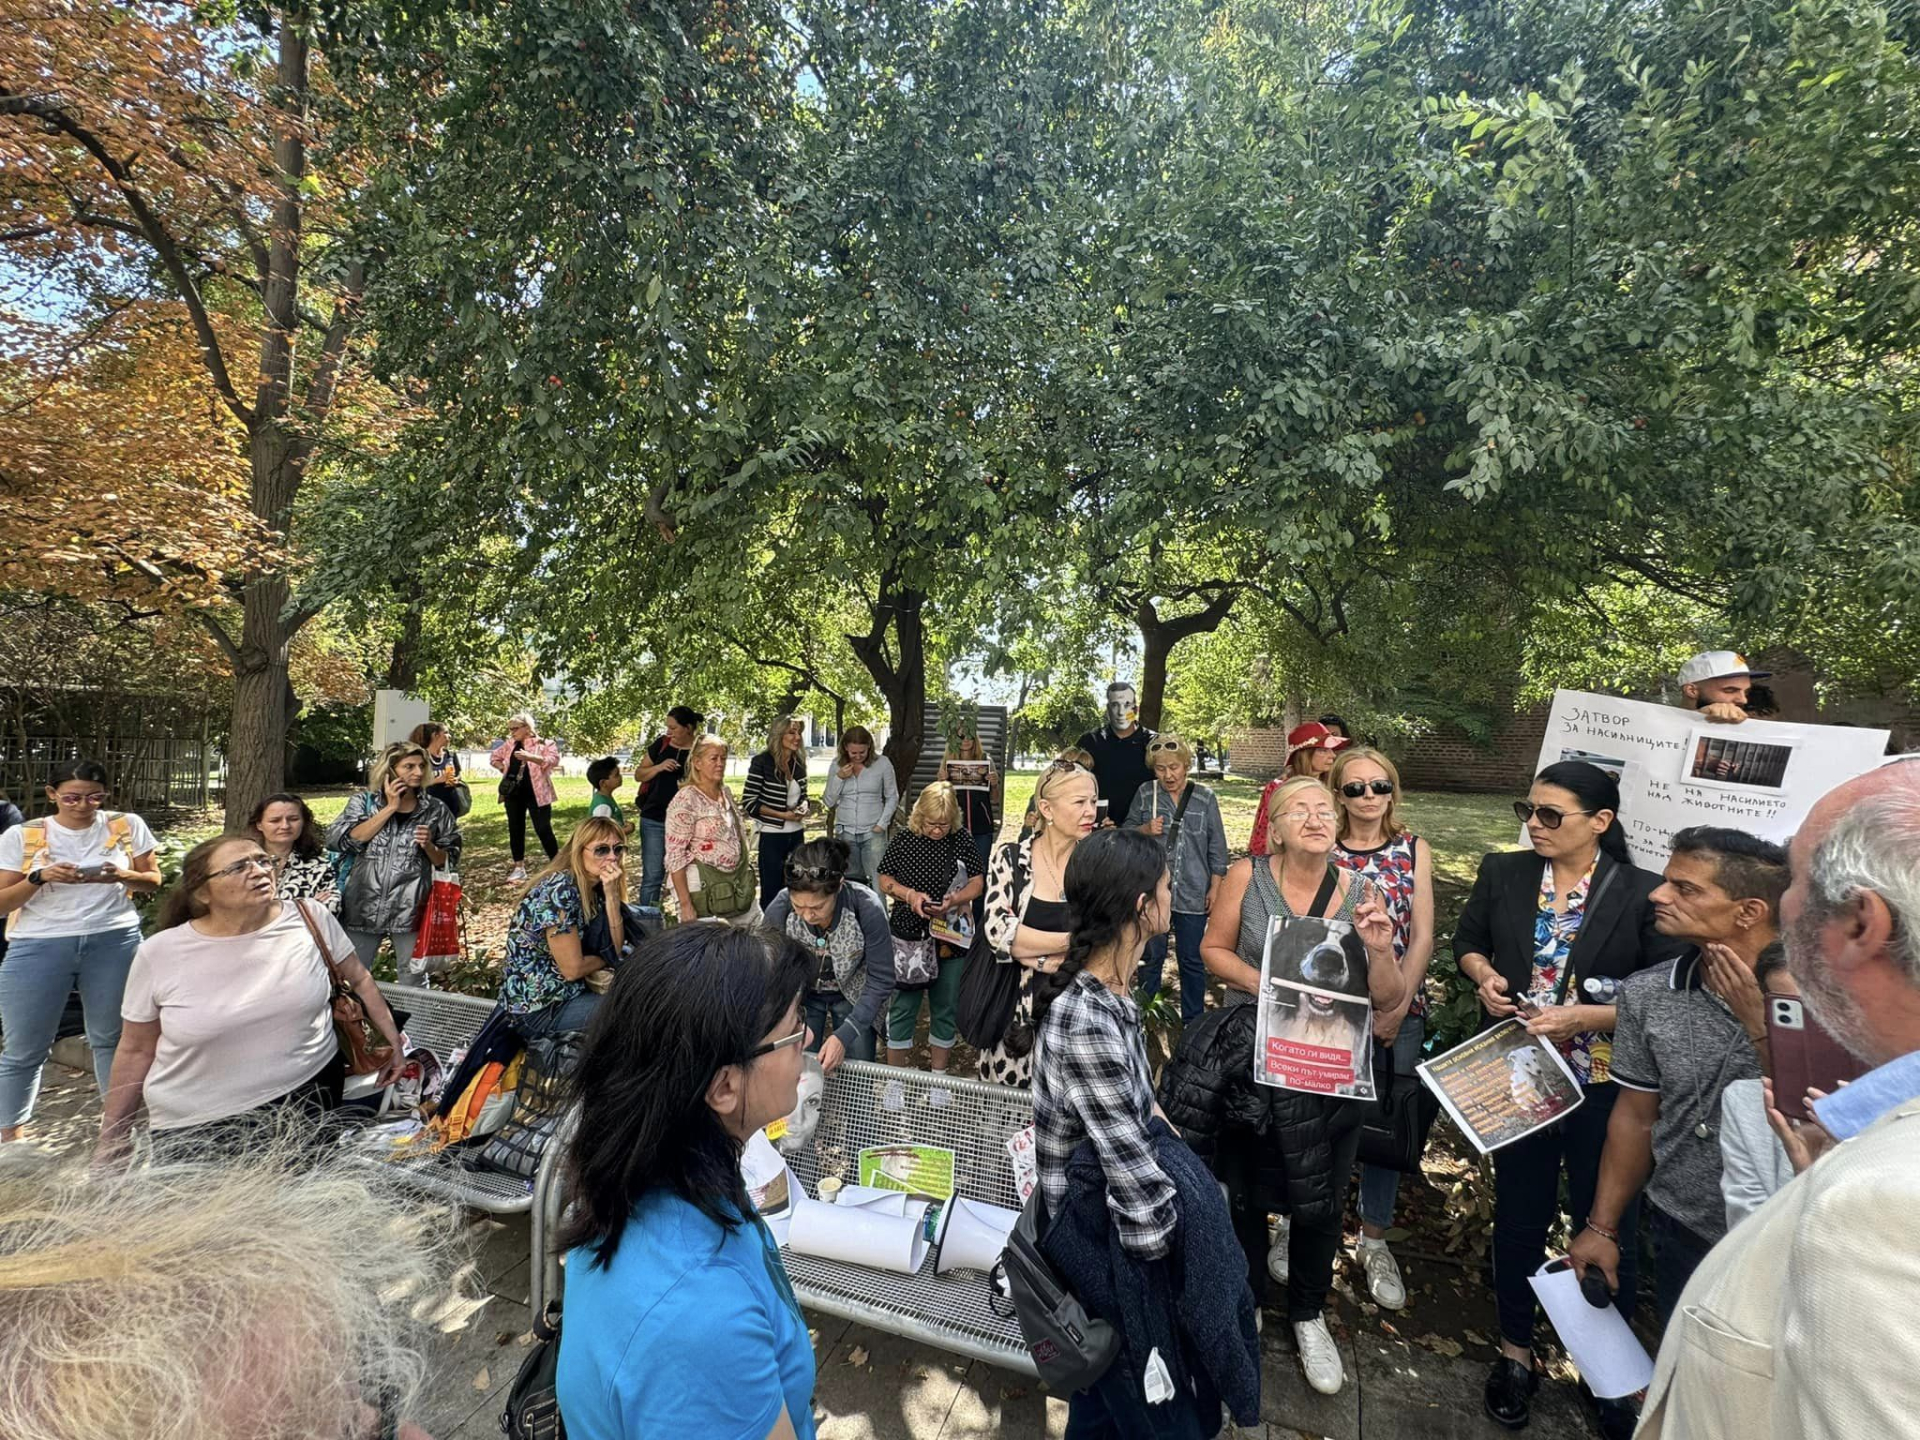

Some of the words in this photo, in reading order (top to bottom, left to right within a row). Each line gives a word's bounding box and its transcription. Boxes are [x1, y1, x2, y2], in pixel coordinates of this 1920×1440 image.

[1561, 707, 1630, 726] ЗАТВОР
[1560, 722, 1579, 733] ЗА
[1649, 780, 1670, 790] НЕ
[1720, 793, 1786, 808] НАСИЛИЕТО
[1271, 1041, 1306, 1056] Когато
[1270, 1060, 1299, 1073] Всеки
[1289, 1077, 1332, 1090] по-малко
